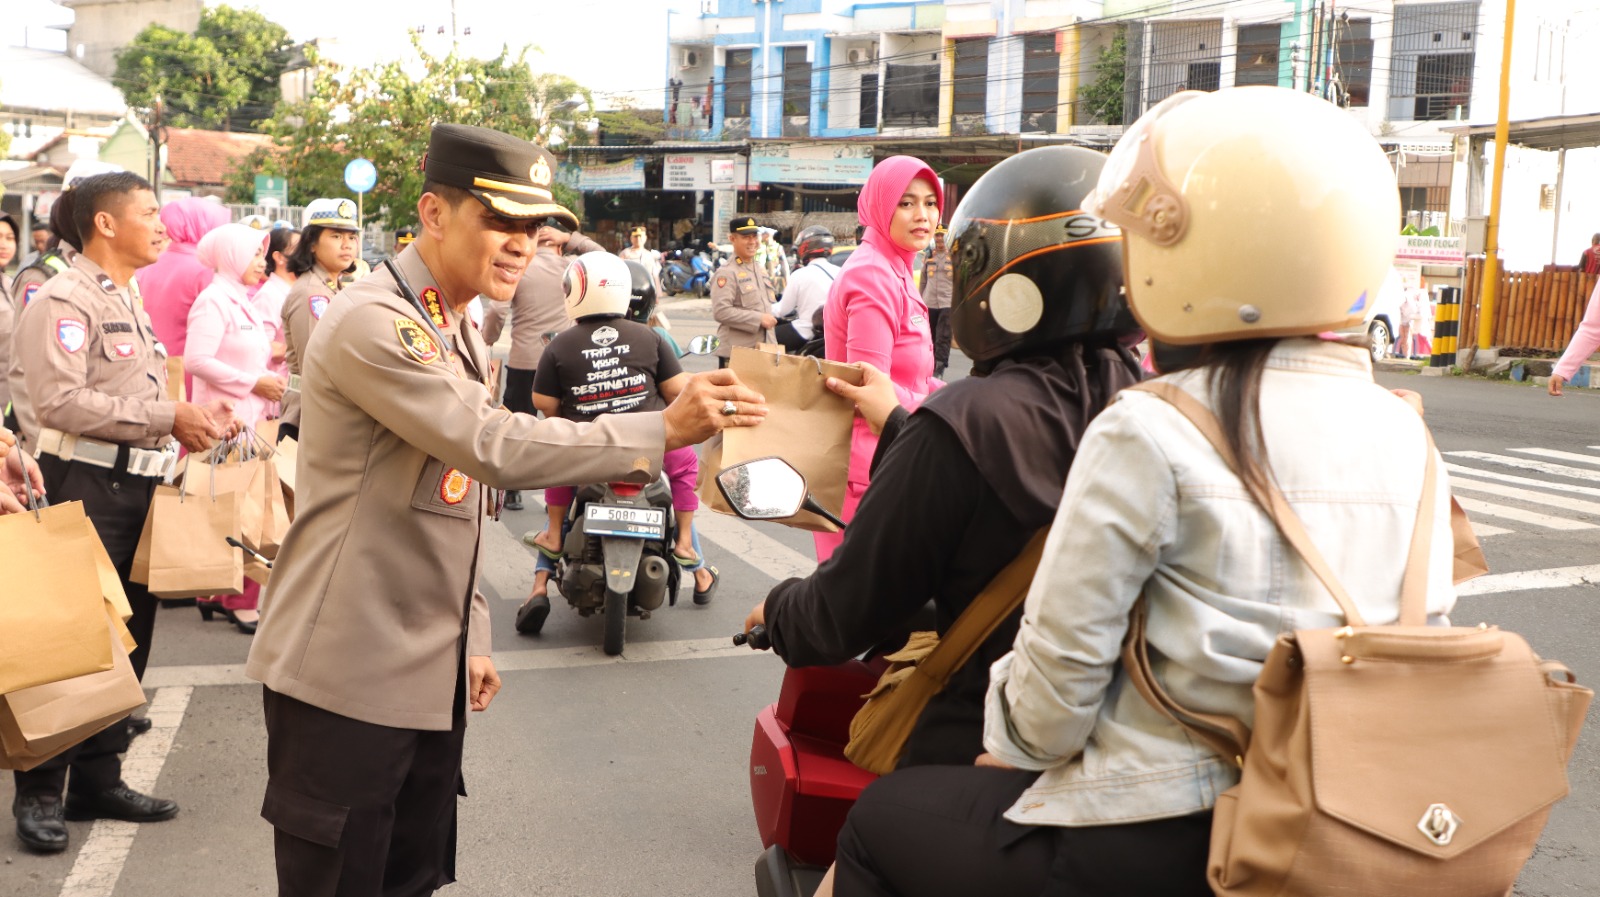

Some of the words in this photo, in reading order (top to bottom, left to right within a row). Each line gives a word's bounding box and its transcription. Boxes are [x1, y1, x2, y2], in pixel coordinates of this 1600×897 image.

[666, 155, 695, 164] Canon
[1408, 238, 1432, 248] KEDAI
[581, 347, 612, 359] TRIP
[614, 344, 630, 355] TO
[592, 357, 620, 370] YOUR
[586, 366, 628, 382] DREAM
[571, 373, 647, 396] DESTINATION
[591, 508, 598, 518] P
[608, 509, 636, 521] 5080
[645, 512, 660, 523] VJ
